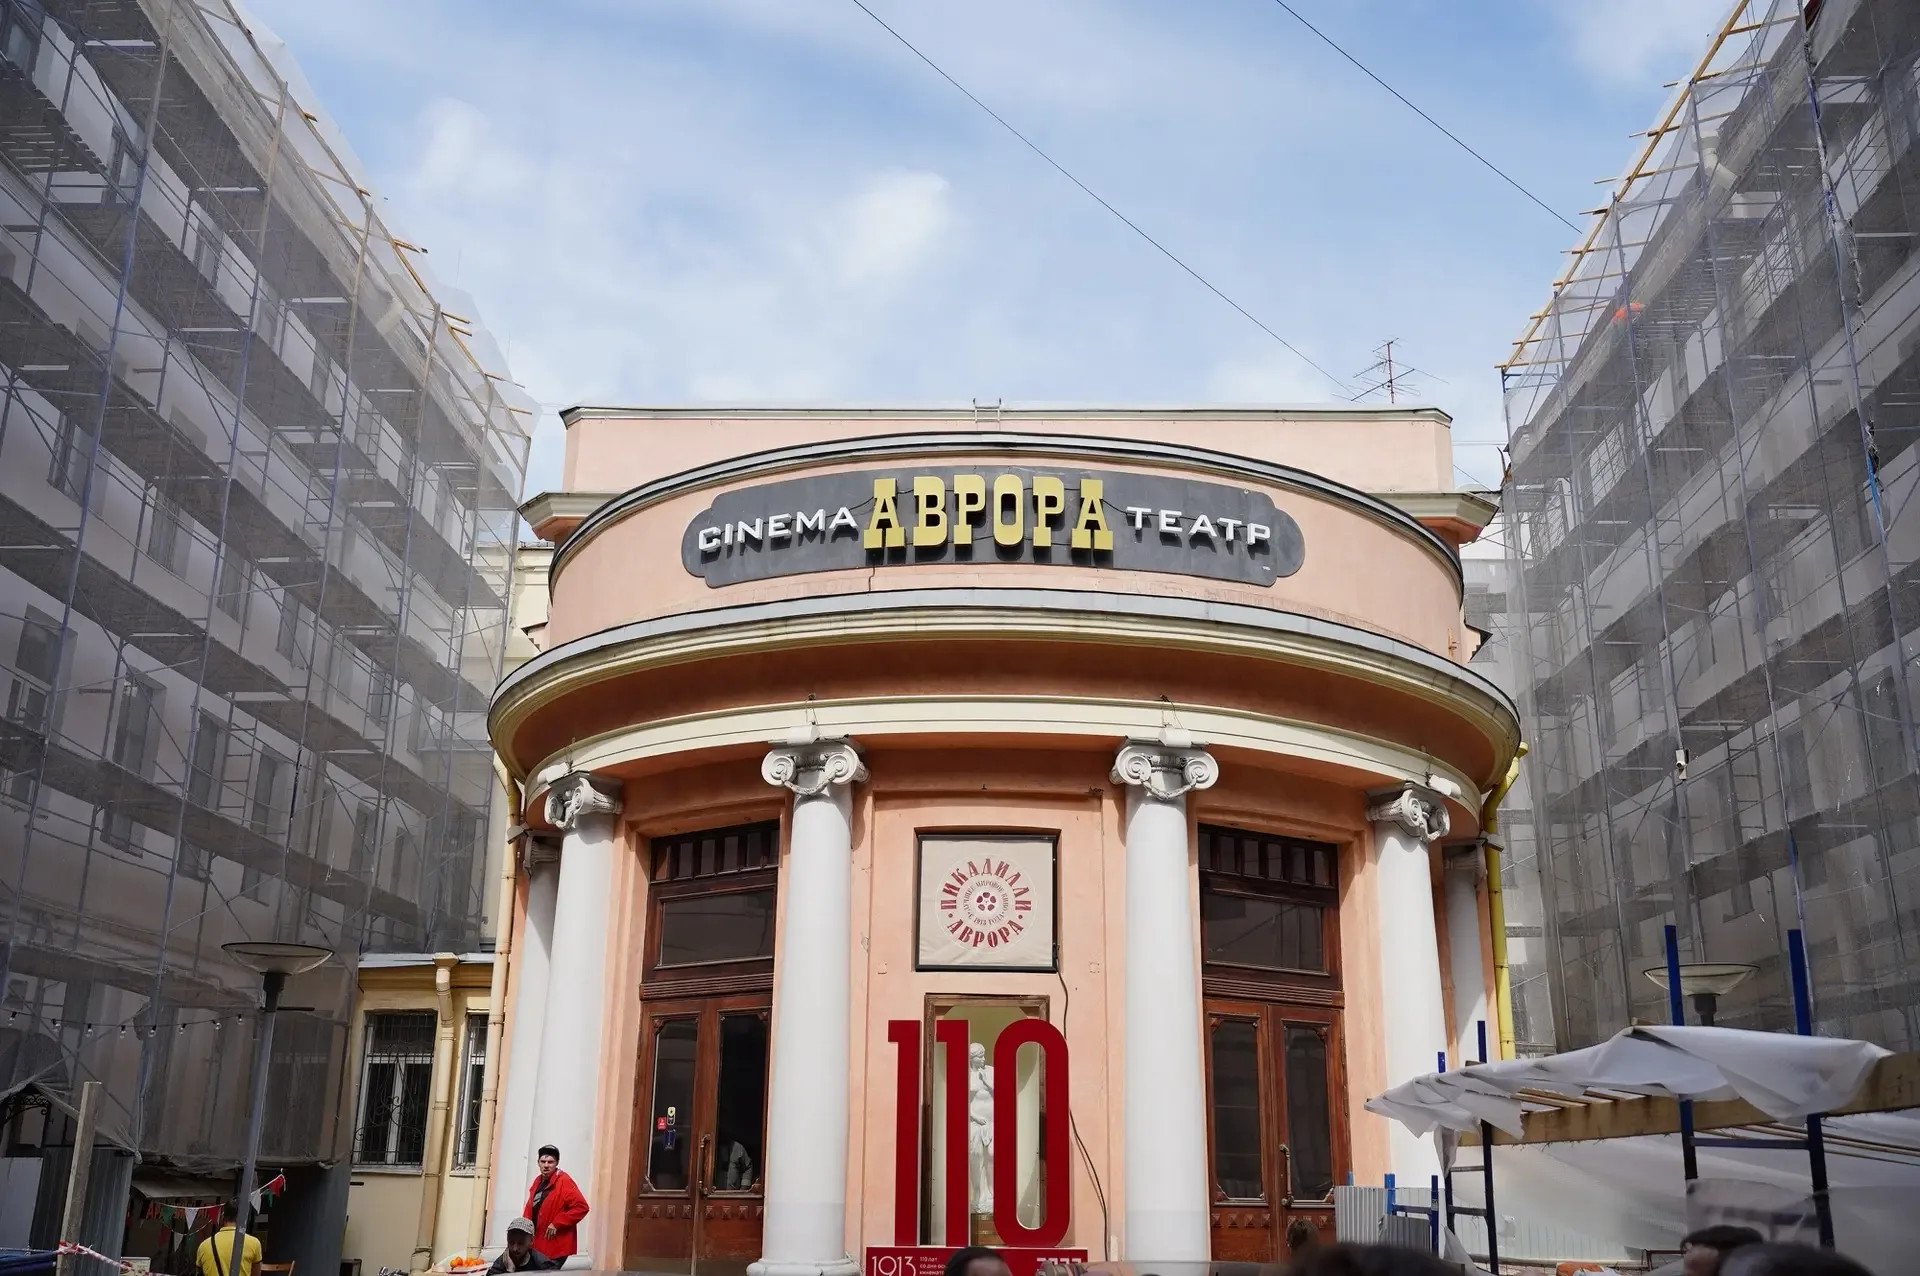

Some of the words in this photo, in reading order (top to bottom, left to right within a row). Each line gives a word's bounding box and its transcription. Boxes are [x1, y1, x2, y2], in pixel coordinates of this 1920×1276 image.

[698, 506, 859, 552] CINEMA
[863, 474, 1113, 551] АВРОРА
[1126, 505, 1271, 546] ТЕАТР
[940, 858, 1032, 911] ПИКАДИЛЛИ
[947, 919, 1024, 948] АВРОРА
[888, 1018, 1070, 1248] 110
[871, 1255, 917, 1276] 1913
